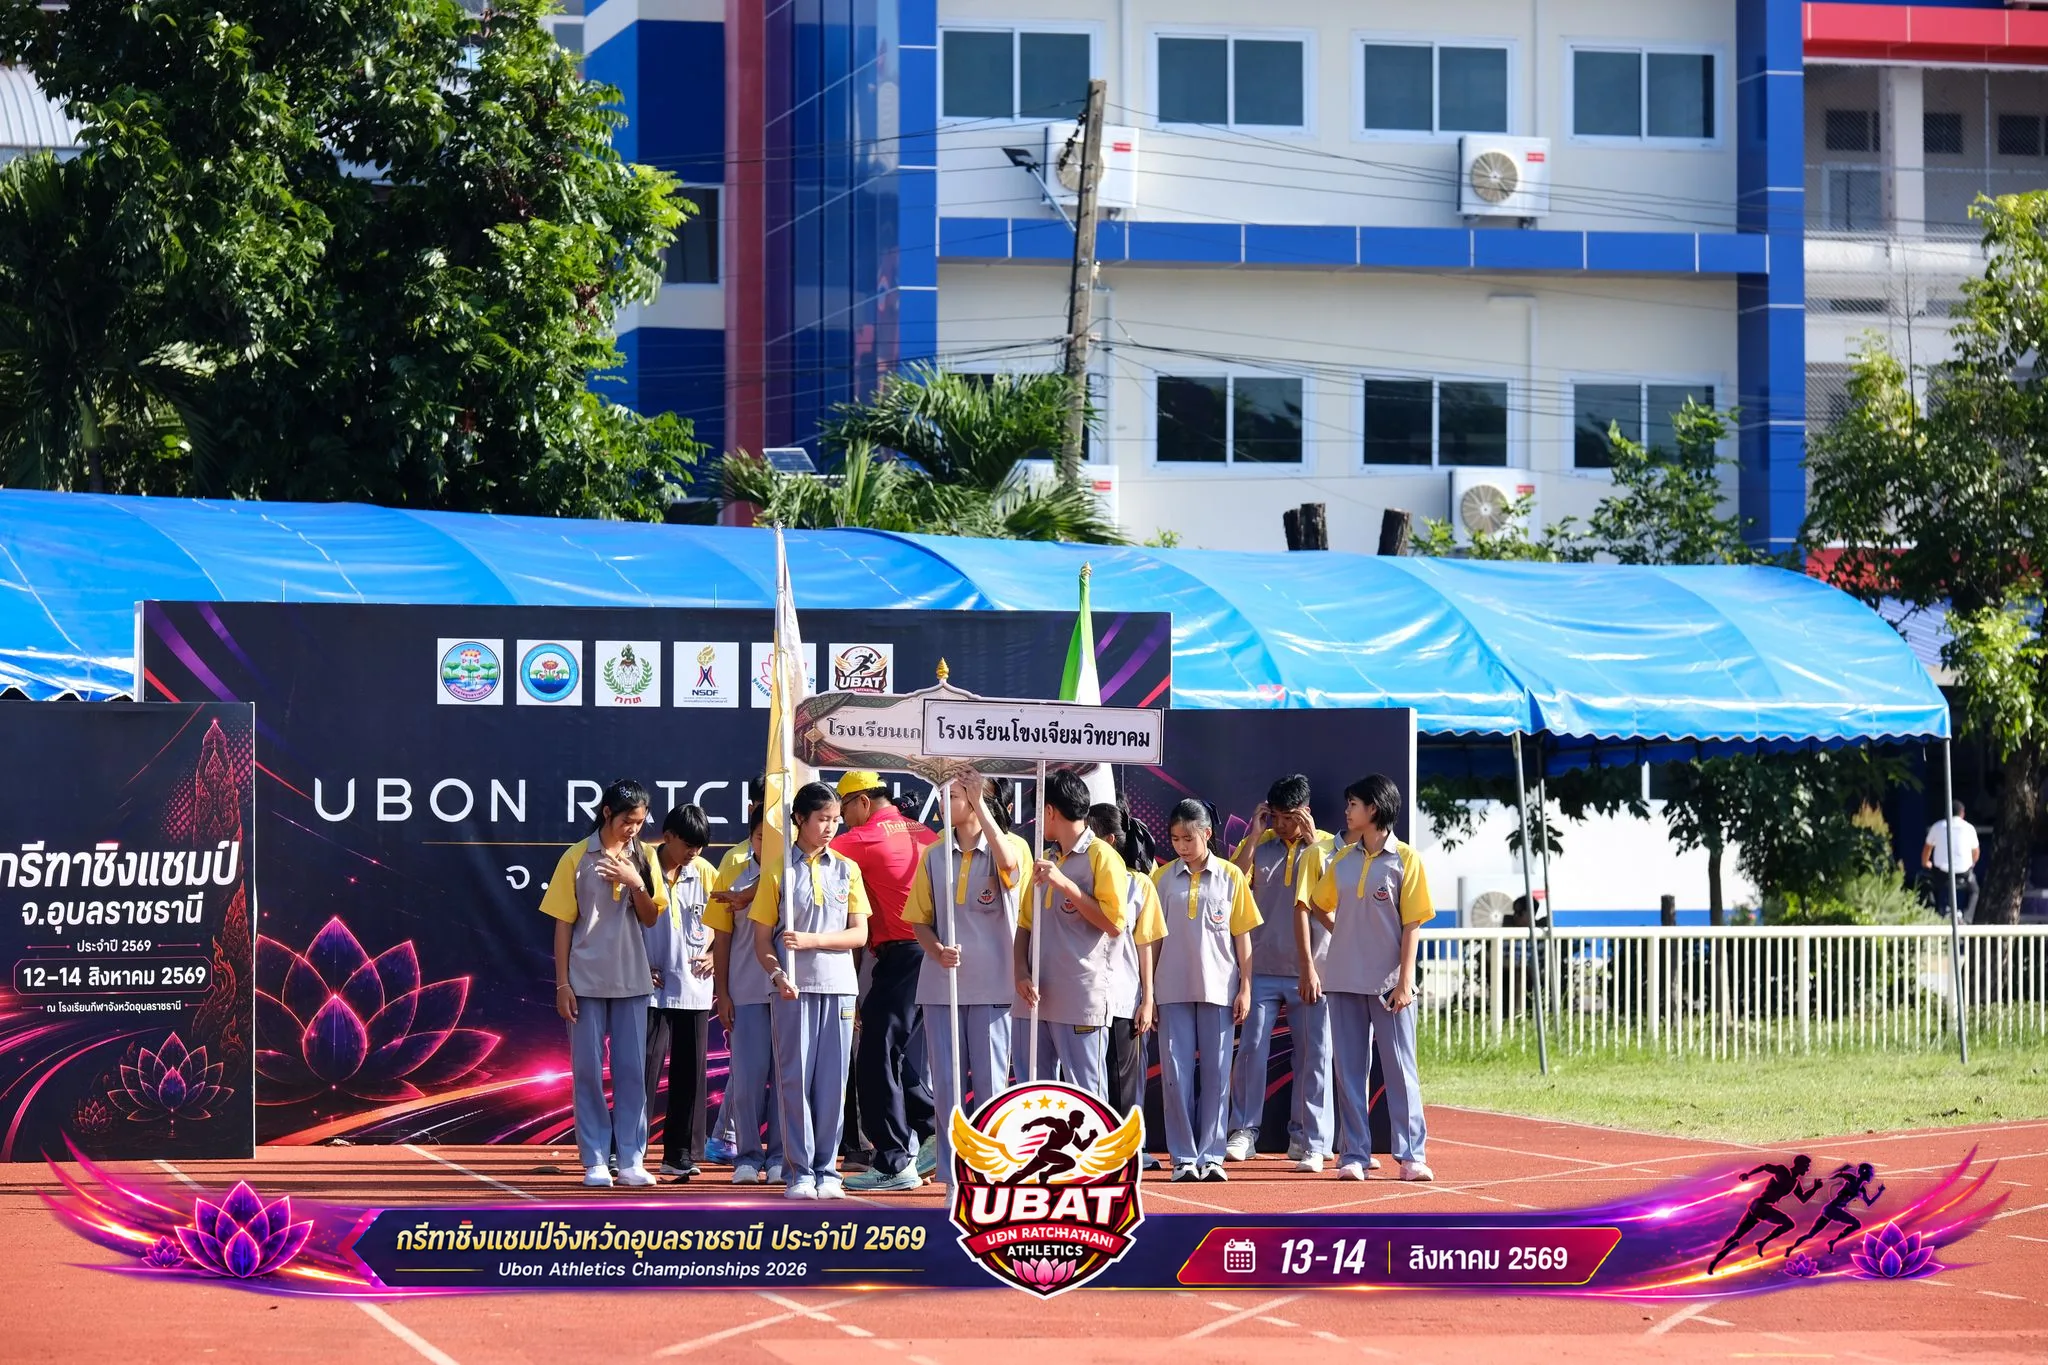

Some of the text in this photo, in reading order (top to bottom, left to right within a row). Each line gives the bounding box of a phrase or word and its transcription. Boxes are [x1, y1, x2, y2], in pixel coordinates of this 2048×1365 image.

[839, 676, 884, 688] UBAT
[691, 689, 719, 697] NSDF
[827, 717, 921, 739] โรงเรียนเก
[936, 716, 1151, 748] โรงเรียนโขงเจียมวิทยาคม
[314, 777, 526, 823] UBON
[21, 891, 204, 935] จ.อุบลราชธานี
[76, 939, 152, 953] ประจำปี 2569
[88, 966, 155, 987] สิงหาคม
[161, 967, 206, 985] 2569
[46, 1000, 182, 1015] ณ โรงเรียนกีฬาจังหวัดอุบลราชธานี
